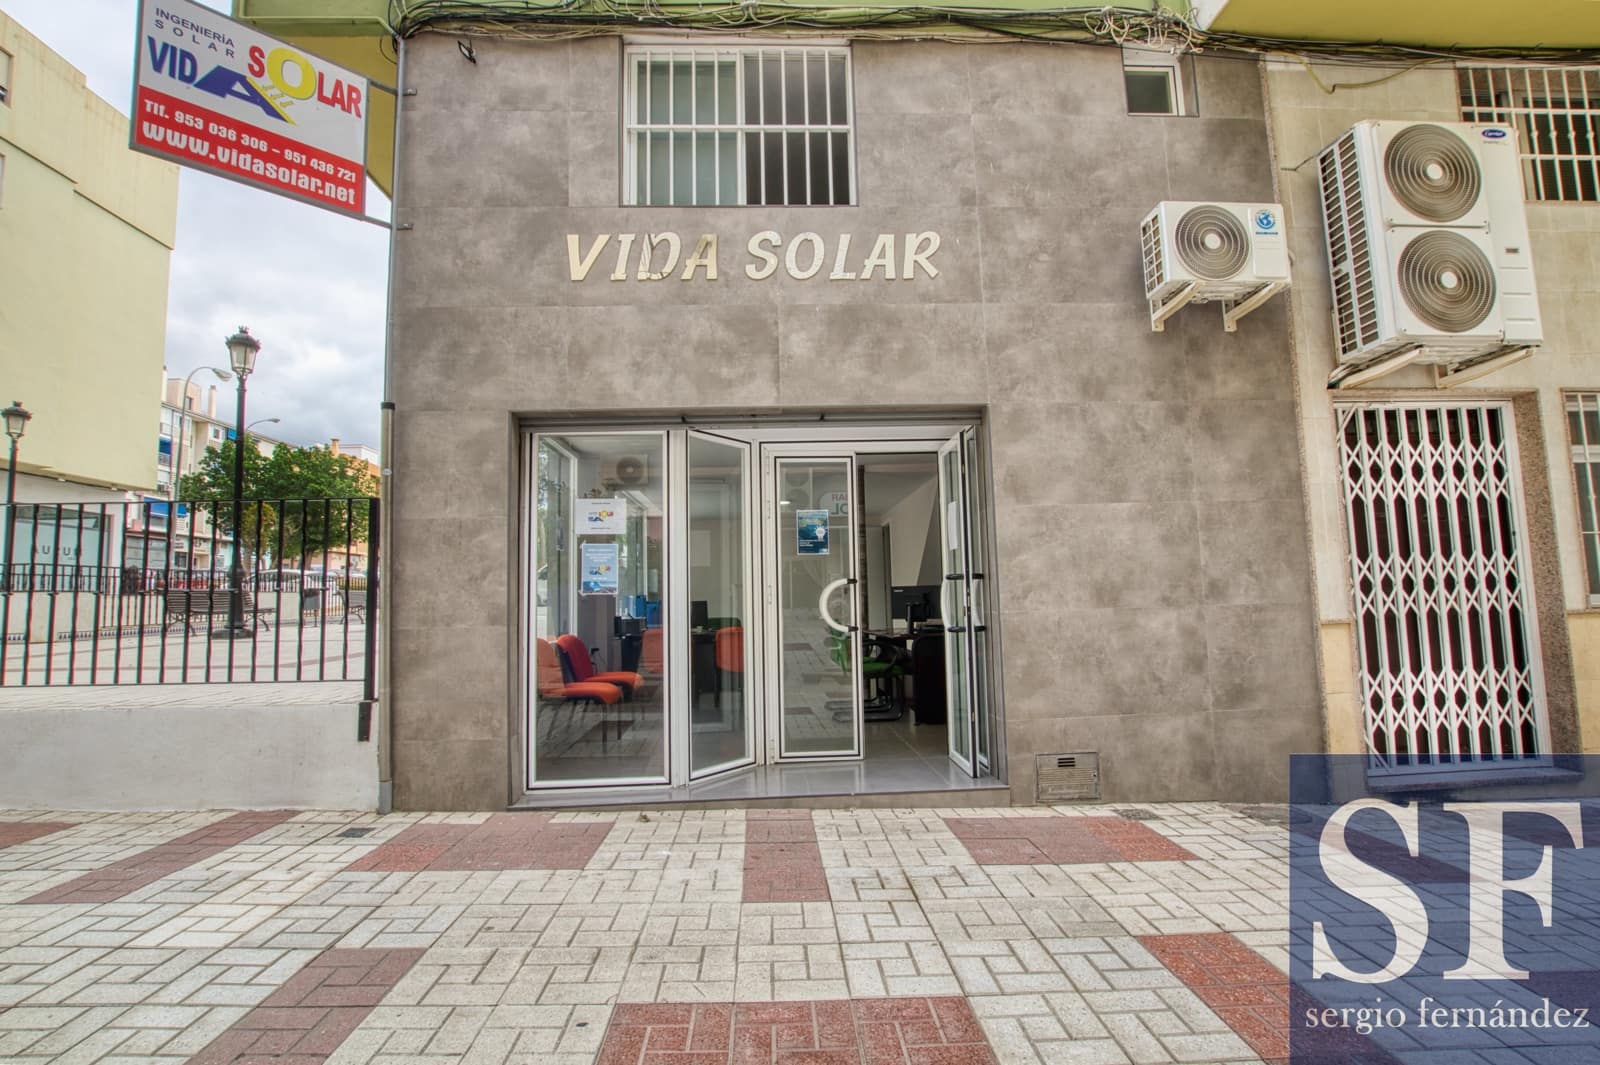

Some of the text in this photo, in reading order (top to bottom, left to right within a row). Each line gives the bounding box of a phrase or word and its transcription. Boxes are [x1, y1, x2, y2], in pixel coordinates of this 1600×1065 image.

[147, 35, 363, 125] VIDA SOLAR
[142, 120, 356, 205] www.vidasolar.net
[174, 110, 204, 130] 953
[208, 122, 237, 142] 036
[240, 133, 268, 153] 306
[284, 148, 307, 167] 951
[337, 167, 356, 183] 721
[566, 230, 941, 282] VIDA SOLAR
